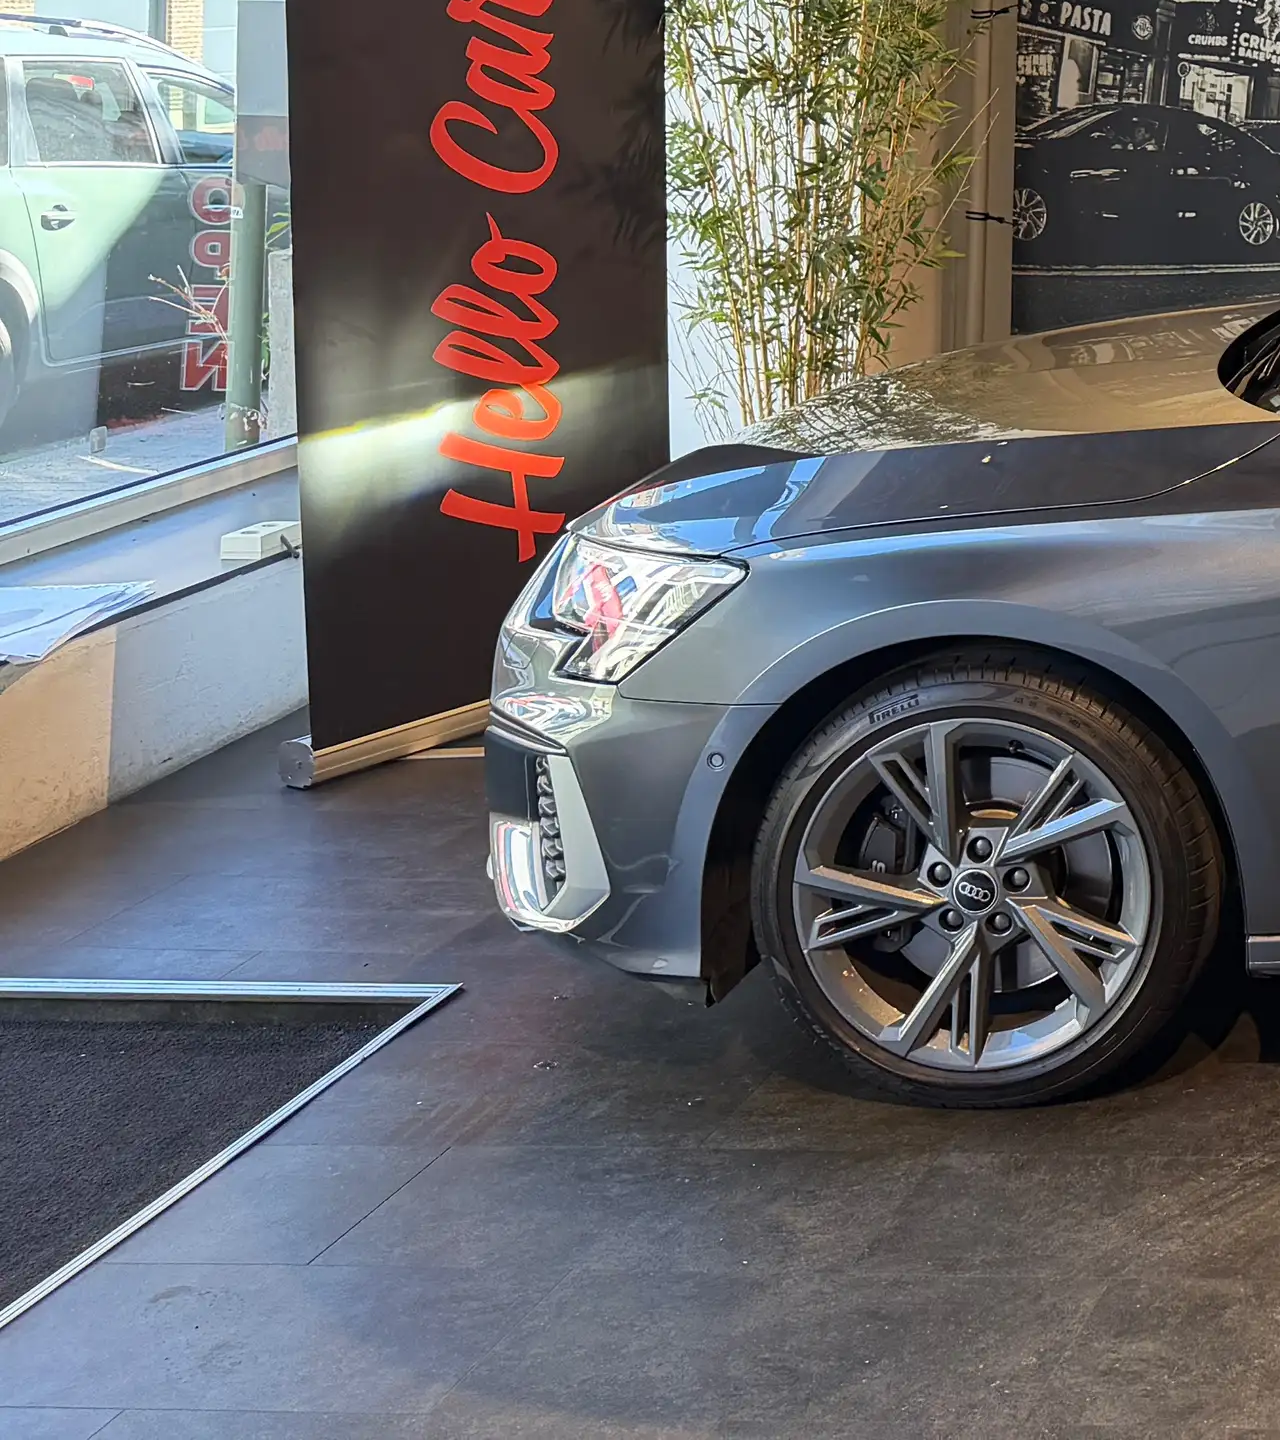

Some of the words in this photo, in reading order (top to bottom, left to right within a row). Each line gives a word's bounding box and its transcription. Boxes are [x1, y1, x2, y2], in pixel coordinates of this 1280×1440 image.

[1059, 1, 1112, 37] PASTA
[1188, 34, 1228, 47] CRUMBS
[432, 212, 566, 561] Hello
[868, 694, 920, 725] PIRELLI
